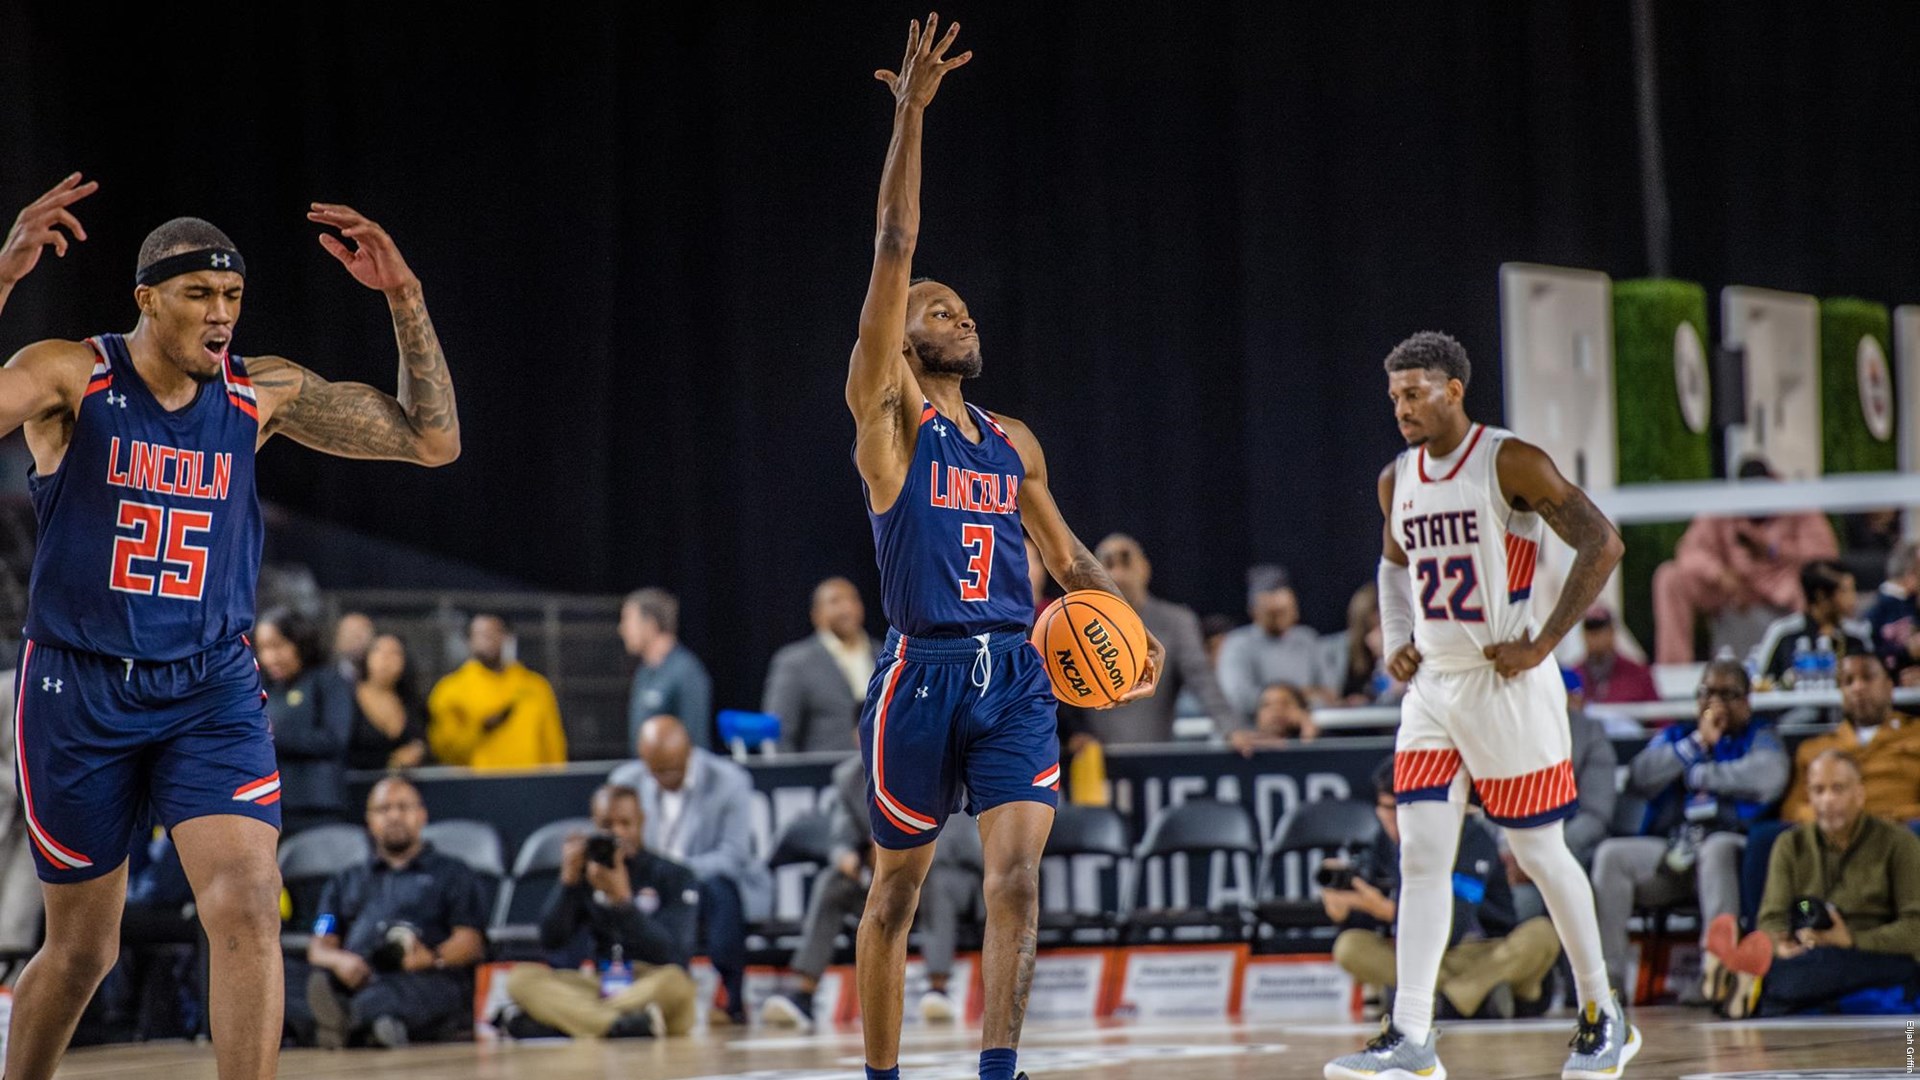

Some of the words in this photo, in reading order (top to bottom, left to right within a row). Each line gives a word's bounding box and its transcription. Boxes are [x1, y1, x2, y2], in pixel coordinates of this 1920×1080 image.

[107, 436, 232, 500] LINCOLN
[931, 460, 1018, 514] LINCOLN
[109, 499, 213, 601] 25
[959, 523, 995, 602] 3
[1402, 509, 1480, 551] STATE
[1416, 554, 1487, 623] 22
[1056, 649, 1092, 697] NCAA
[1083, 618, 1126, 691] Wilson
